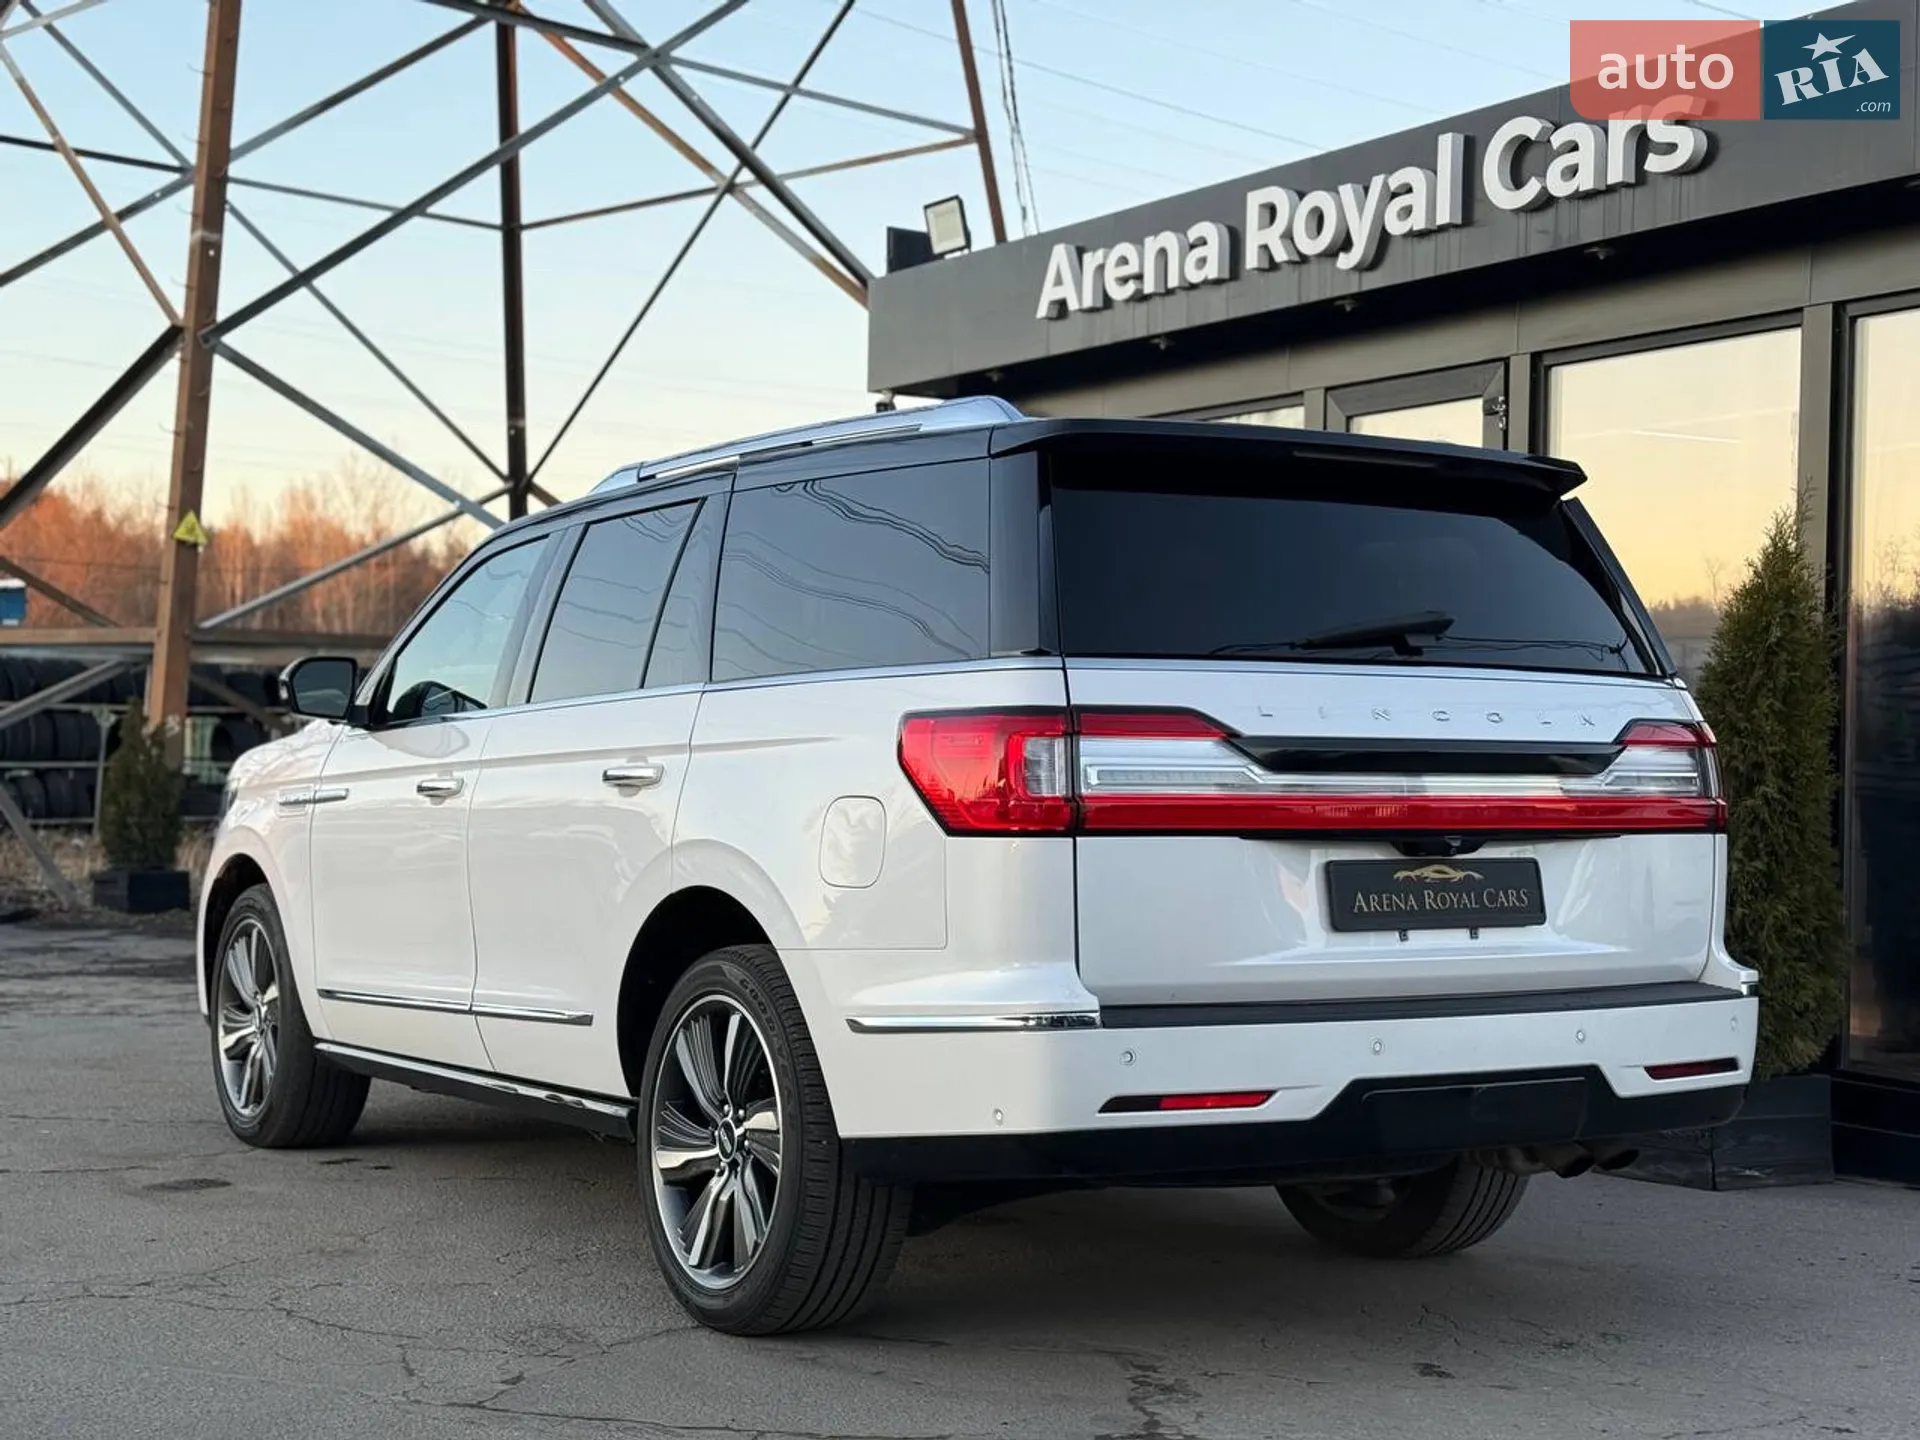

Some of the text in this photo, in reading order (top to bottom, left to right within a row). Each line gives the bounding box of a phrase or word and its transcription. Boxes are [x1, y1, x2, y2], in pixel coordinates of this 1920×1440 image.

[1035, 94, 1709, 320] Arena Royal Cars
[1353, 887, 1530, 914] ARENA ROYAL CARS
